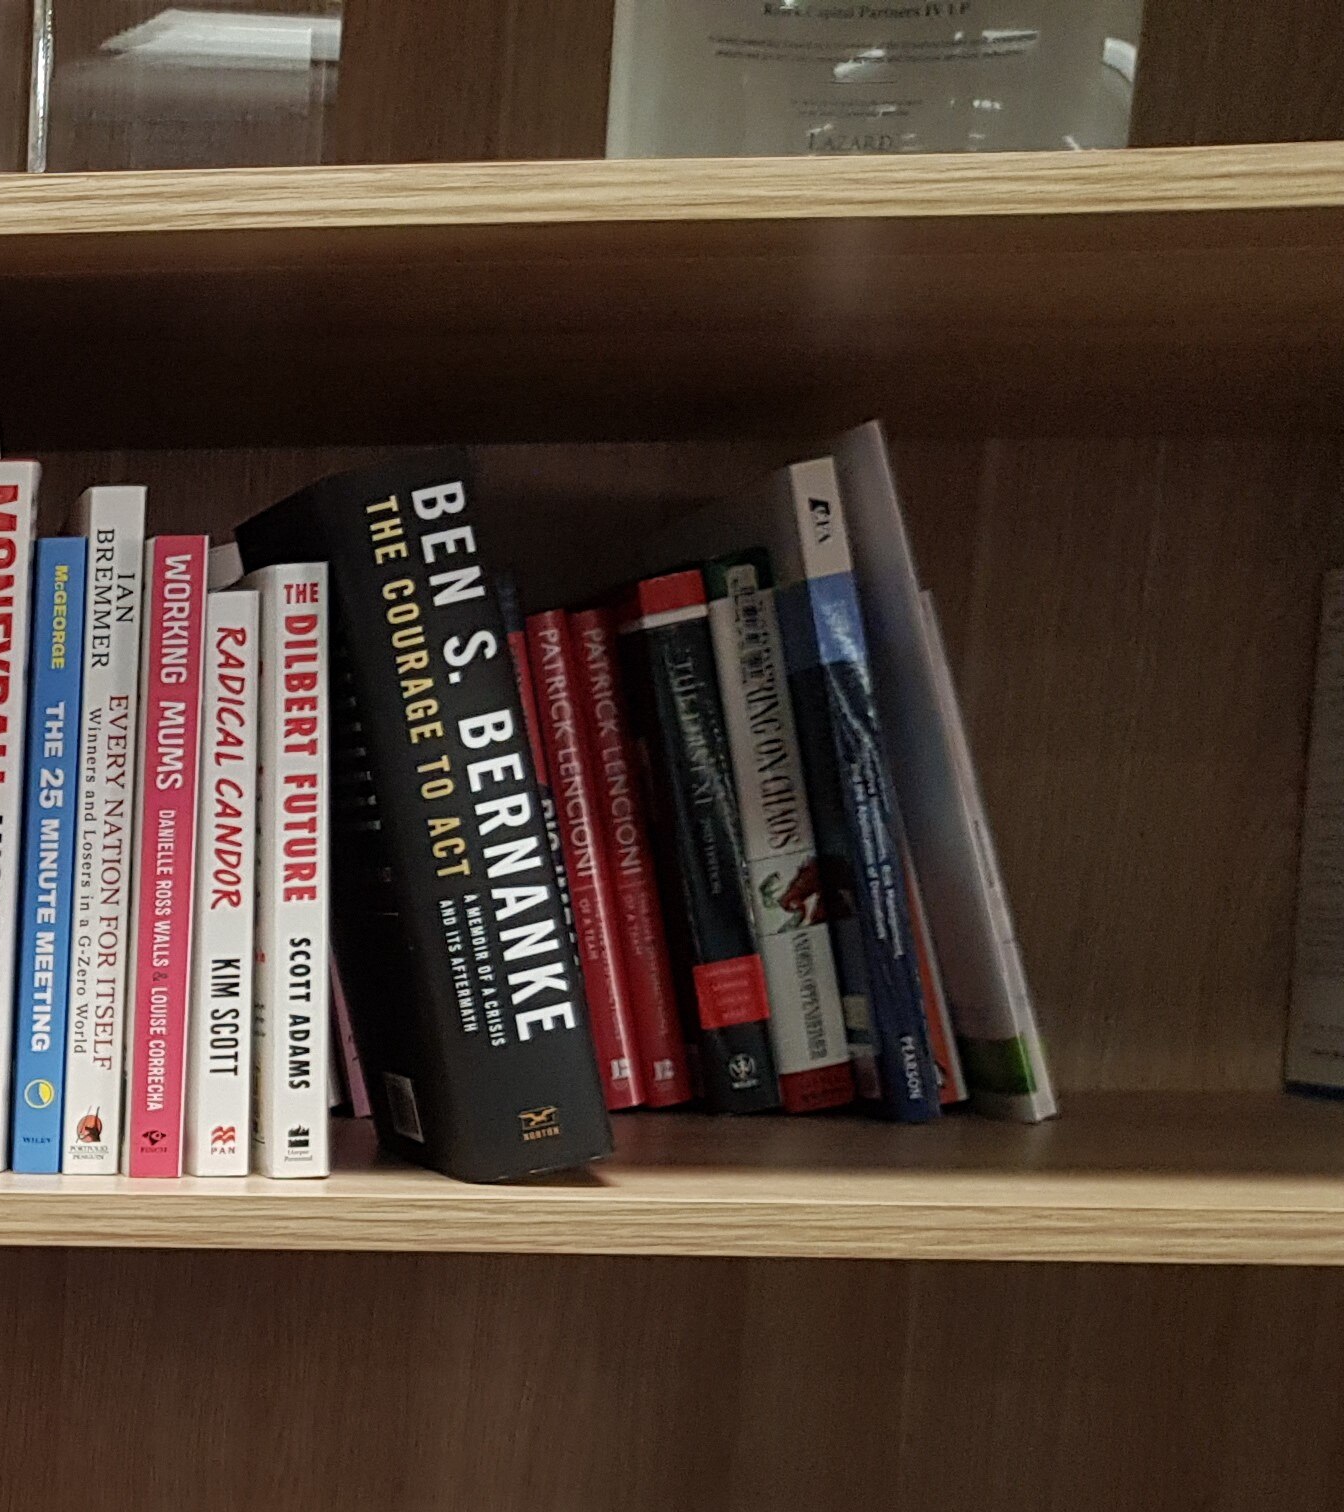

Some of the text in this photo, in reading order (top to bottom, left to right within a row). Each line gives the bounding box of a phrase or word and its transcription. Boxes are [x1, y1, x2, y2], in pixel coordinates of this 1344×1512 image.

[91, 528, 115, 669] BREMMER
[116, 572, 136, 624] IAN
[283, 583, 320, 604] THE
[366, 494, 472, 879] THE COURAGE TO ACT
[411, 480, 577, 1042] BEN BERNANKE
[537, 628, 577, 747] PATRICK
[558, 750, 597, 879] LENCIONI
[30, 700, 65, 1053] THE 25 MINUTE MEETING
[72, 707, 102, 1054] Winners Losers in World
[92, 693, 129, 1071] EVERY NATION FOR ITSELF
[146, 554, 192, 1113] WORKING MUMS DANIELLE ROSS WALLS LOUISE CORRECHA
[209, 626, 248, 1078] RADICAL CANDOR KIM SCOTT
[282, 613, 319, 1091] DILBERT FUTURE SCOTT ADAMS
[450, 954, 479, 1034] AFTERMATH
[465, 905, 507, 1048] MEMOIR CRISIS
